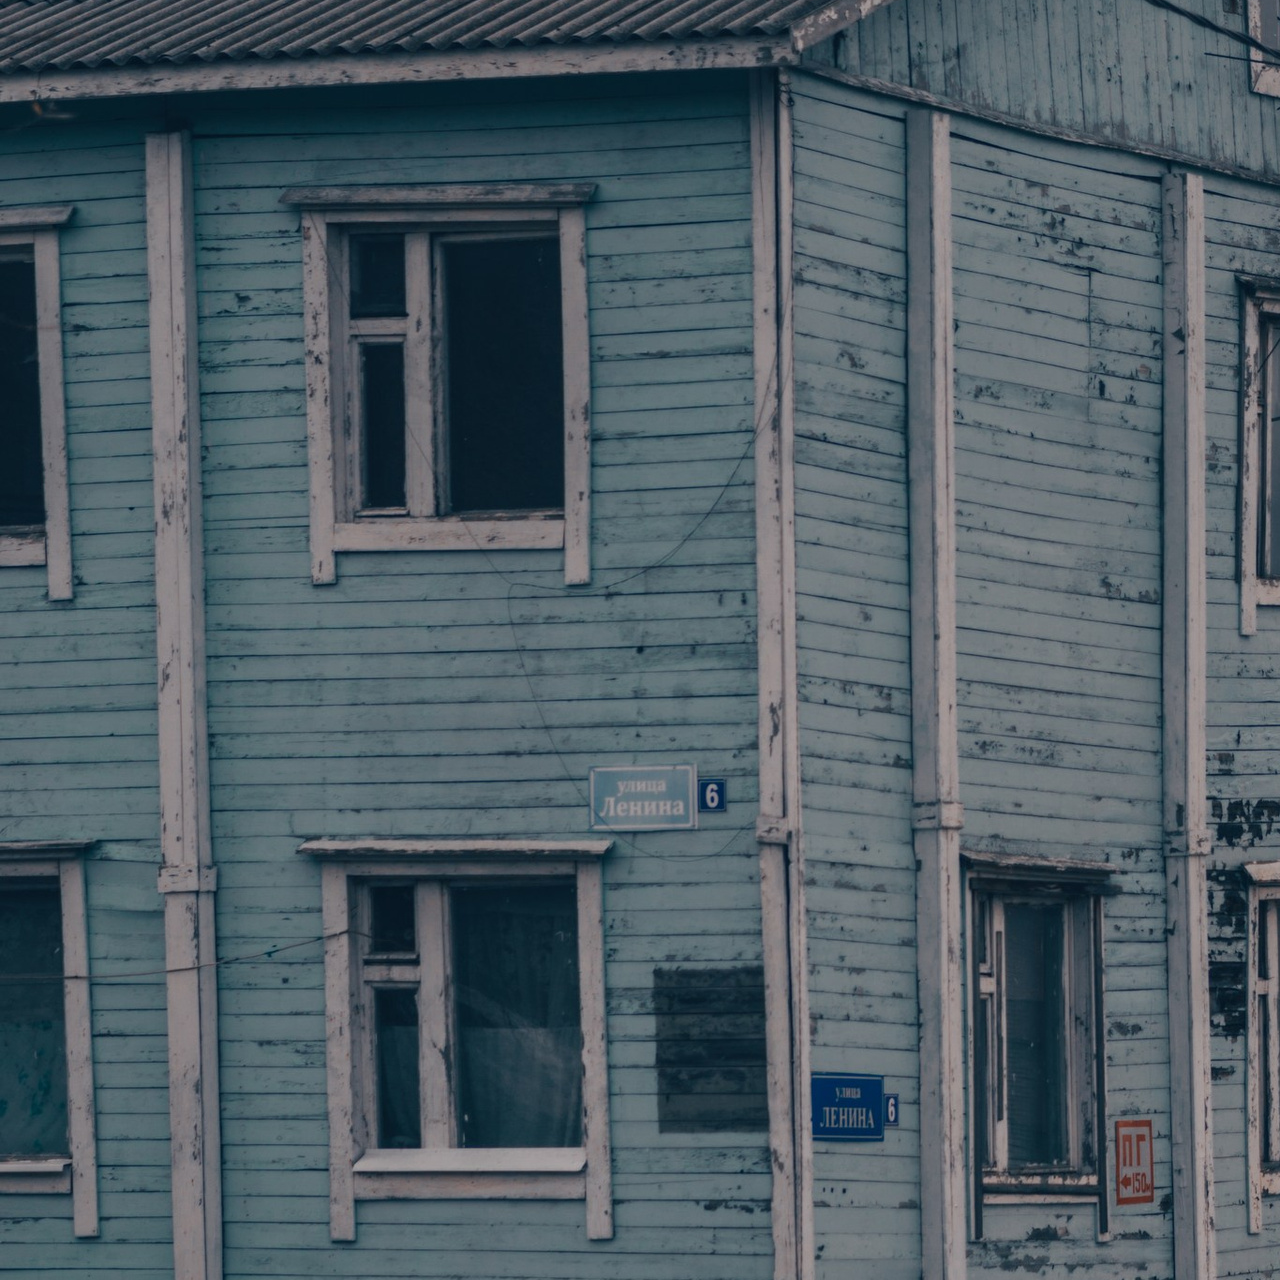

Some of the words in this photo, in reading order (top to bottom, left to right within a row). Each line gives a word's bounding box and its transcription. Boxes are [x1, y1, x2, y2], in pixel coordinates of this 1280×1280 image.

[617, 780, 667, 797] улица
[706, 784, 719, 808] 6
[600, 797, 684, 817] Ленина
[835, 1087, 861, 1102] улица
[820, 1107, 874, 1129] ЛЕНИНА
[888, 1097, 896, 1122] 6
[1122, 1134, 1146, 1167] ПГ
